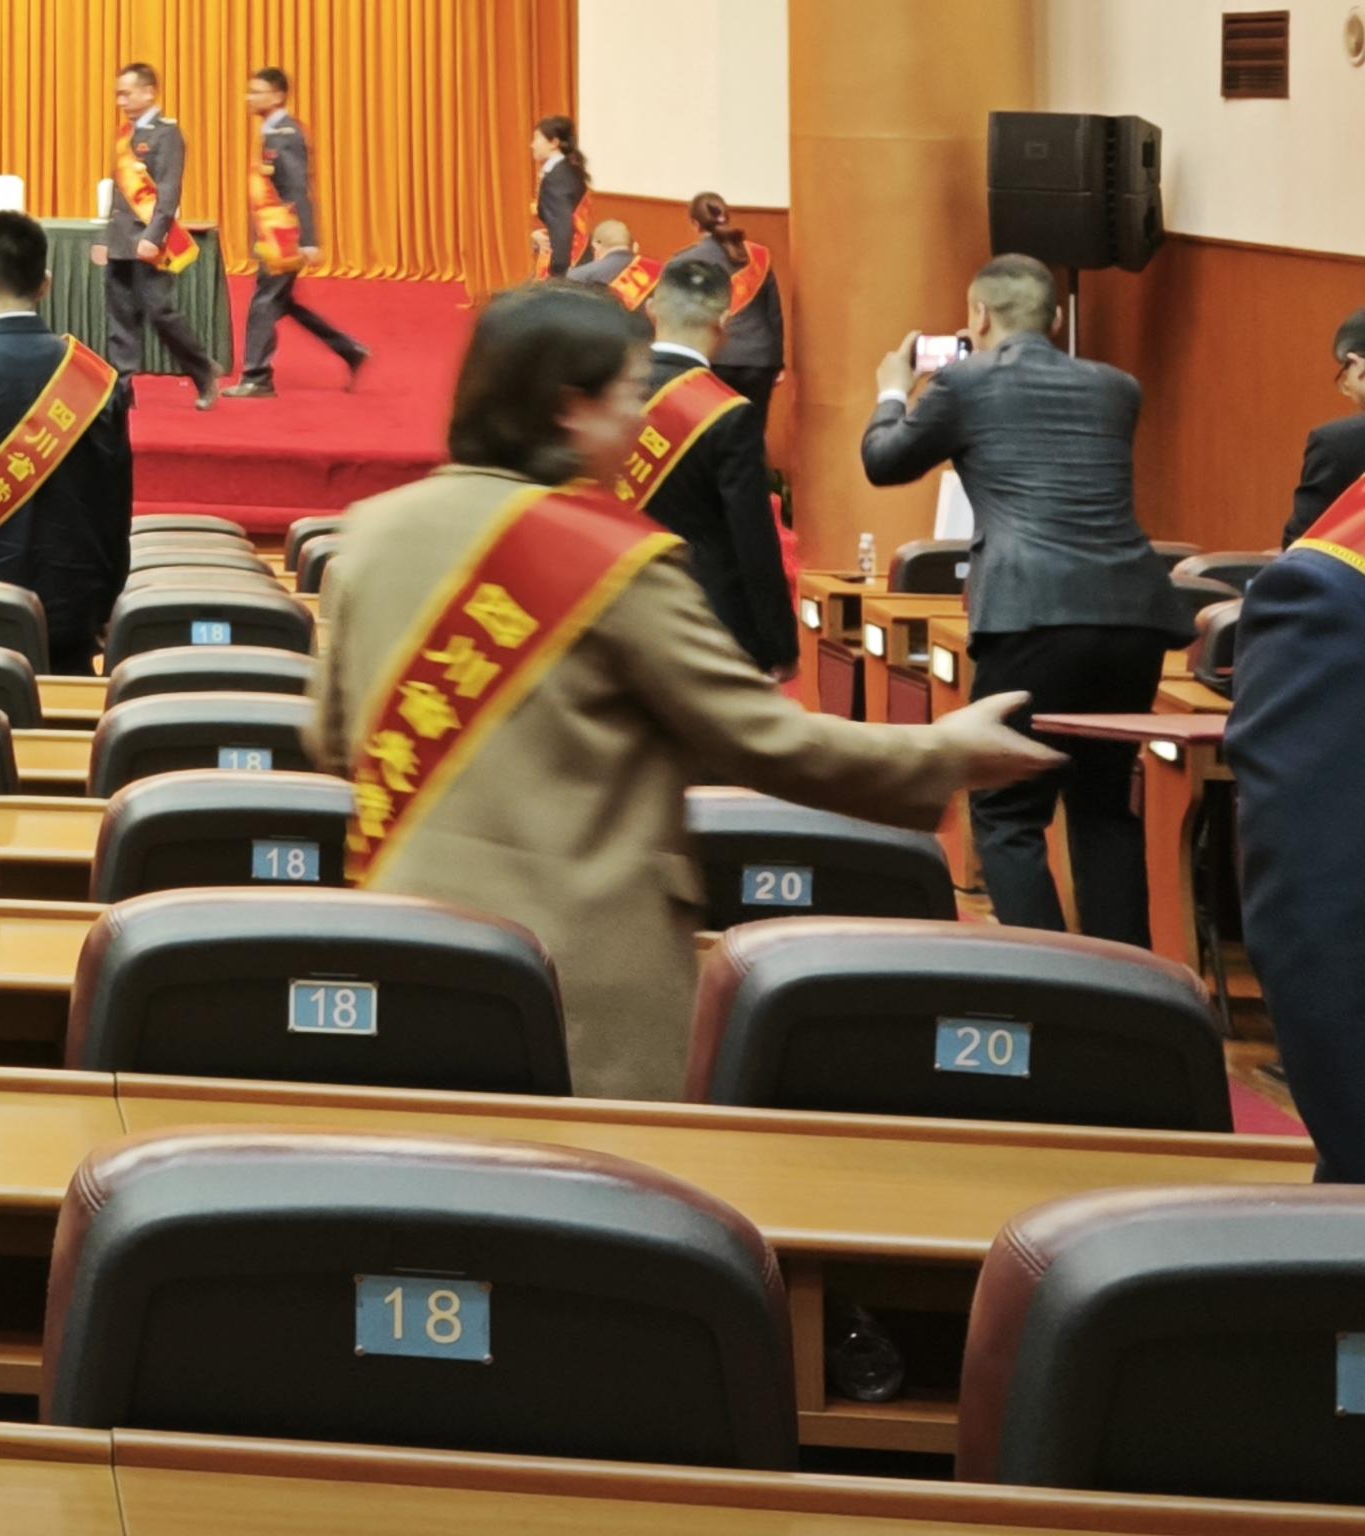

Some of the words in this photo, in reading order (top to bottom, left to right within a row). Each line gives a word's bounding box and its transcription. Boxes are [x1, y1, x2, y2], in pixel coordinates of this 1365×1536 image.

[199, 624, 224, 643] 18
[228, 751, 262, 770] 18
[266, 847, 306, 879] 18
[754, 871, 803, 901] 20
[310, 987, 358, 1027] 18
[953, 1026, 1015, 1068] 20
[384, 1287, 462, 1344] 18
